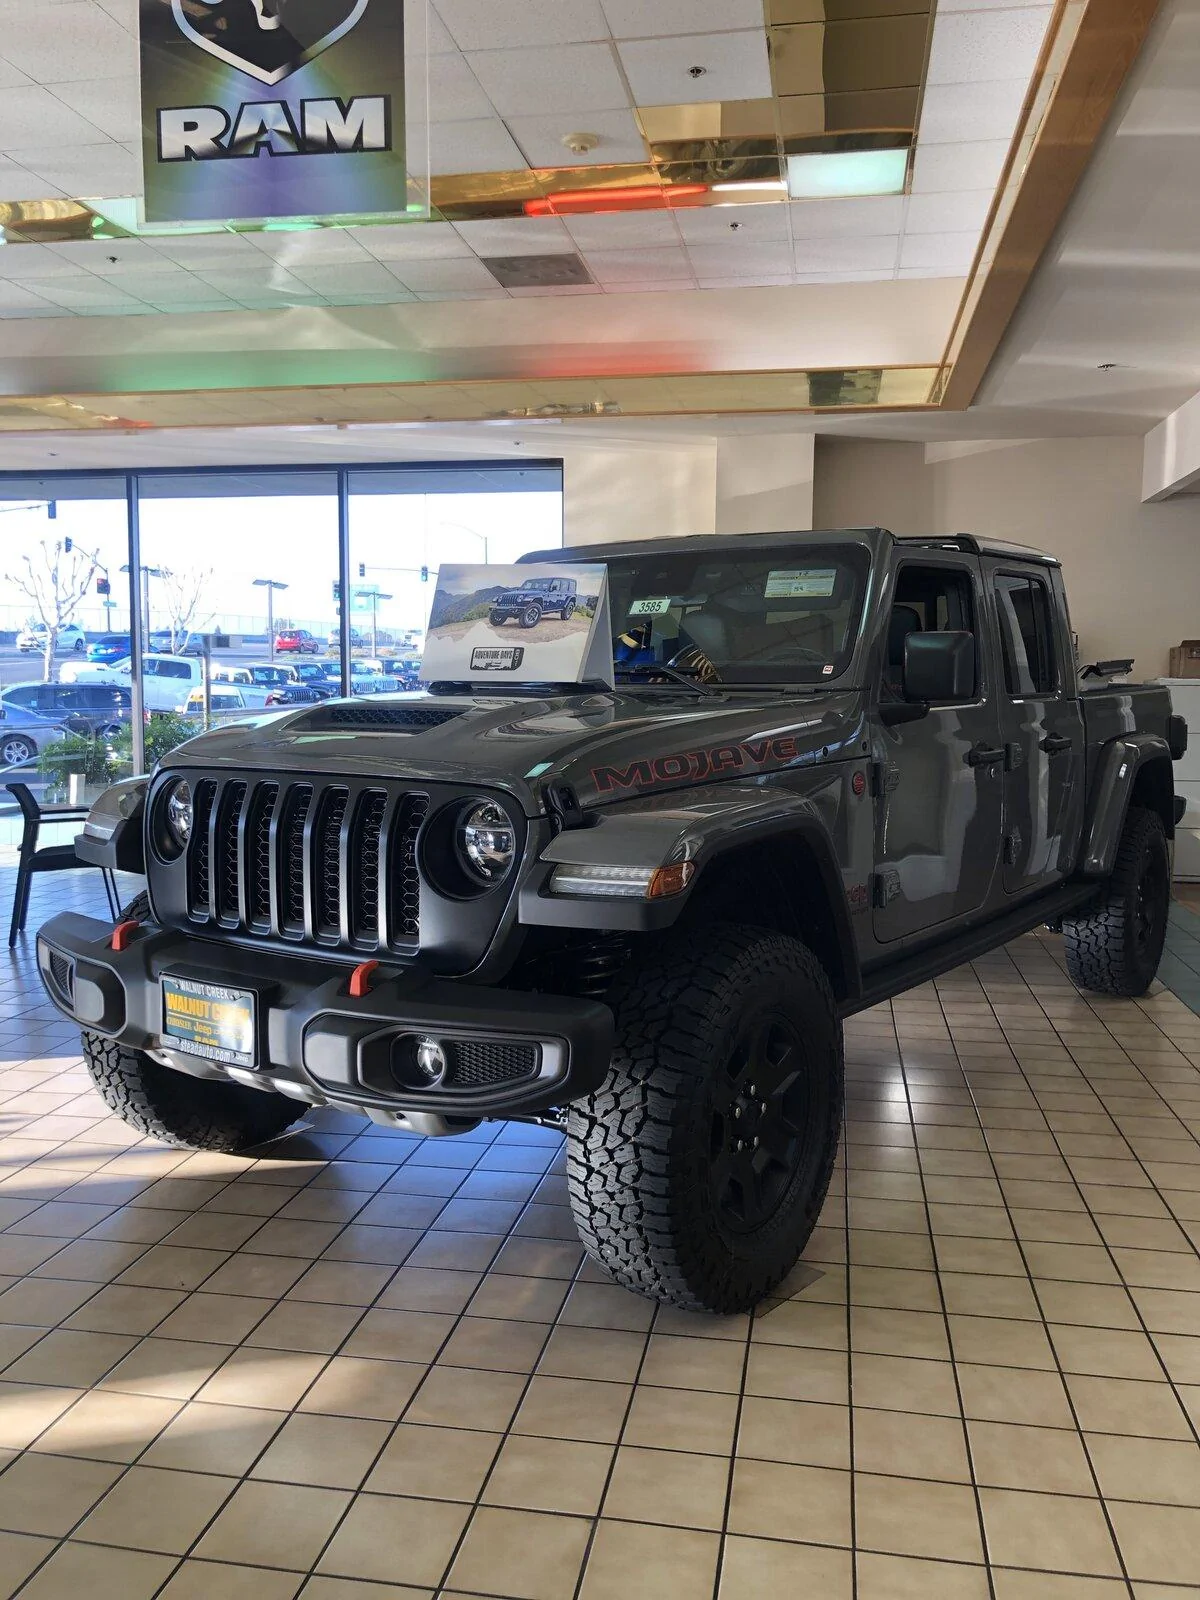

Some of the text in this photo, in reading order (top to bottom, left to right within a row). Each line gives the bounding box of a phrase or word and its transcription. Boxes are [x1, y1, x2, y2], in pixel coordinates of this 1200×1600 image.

[158, 95, 391, 162] RAM
[639, 601, 663, 612] 3585
[475, 650, 499, 659] ADVENTURE
[500, 650, 512, 659] DAYS
[591, 737, 798, 792] MOJAVE
[179, 981, 229, 999] WALNUT CREEK
[166, 993, 209, 1018] WALNUT
[193, 1022, 212, 1035] Jeep
